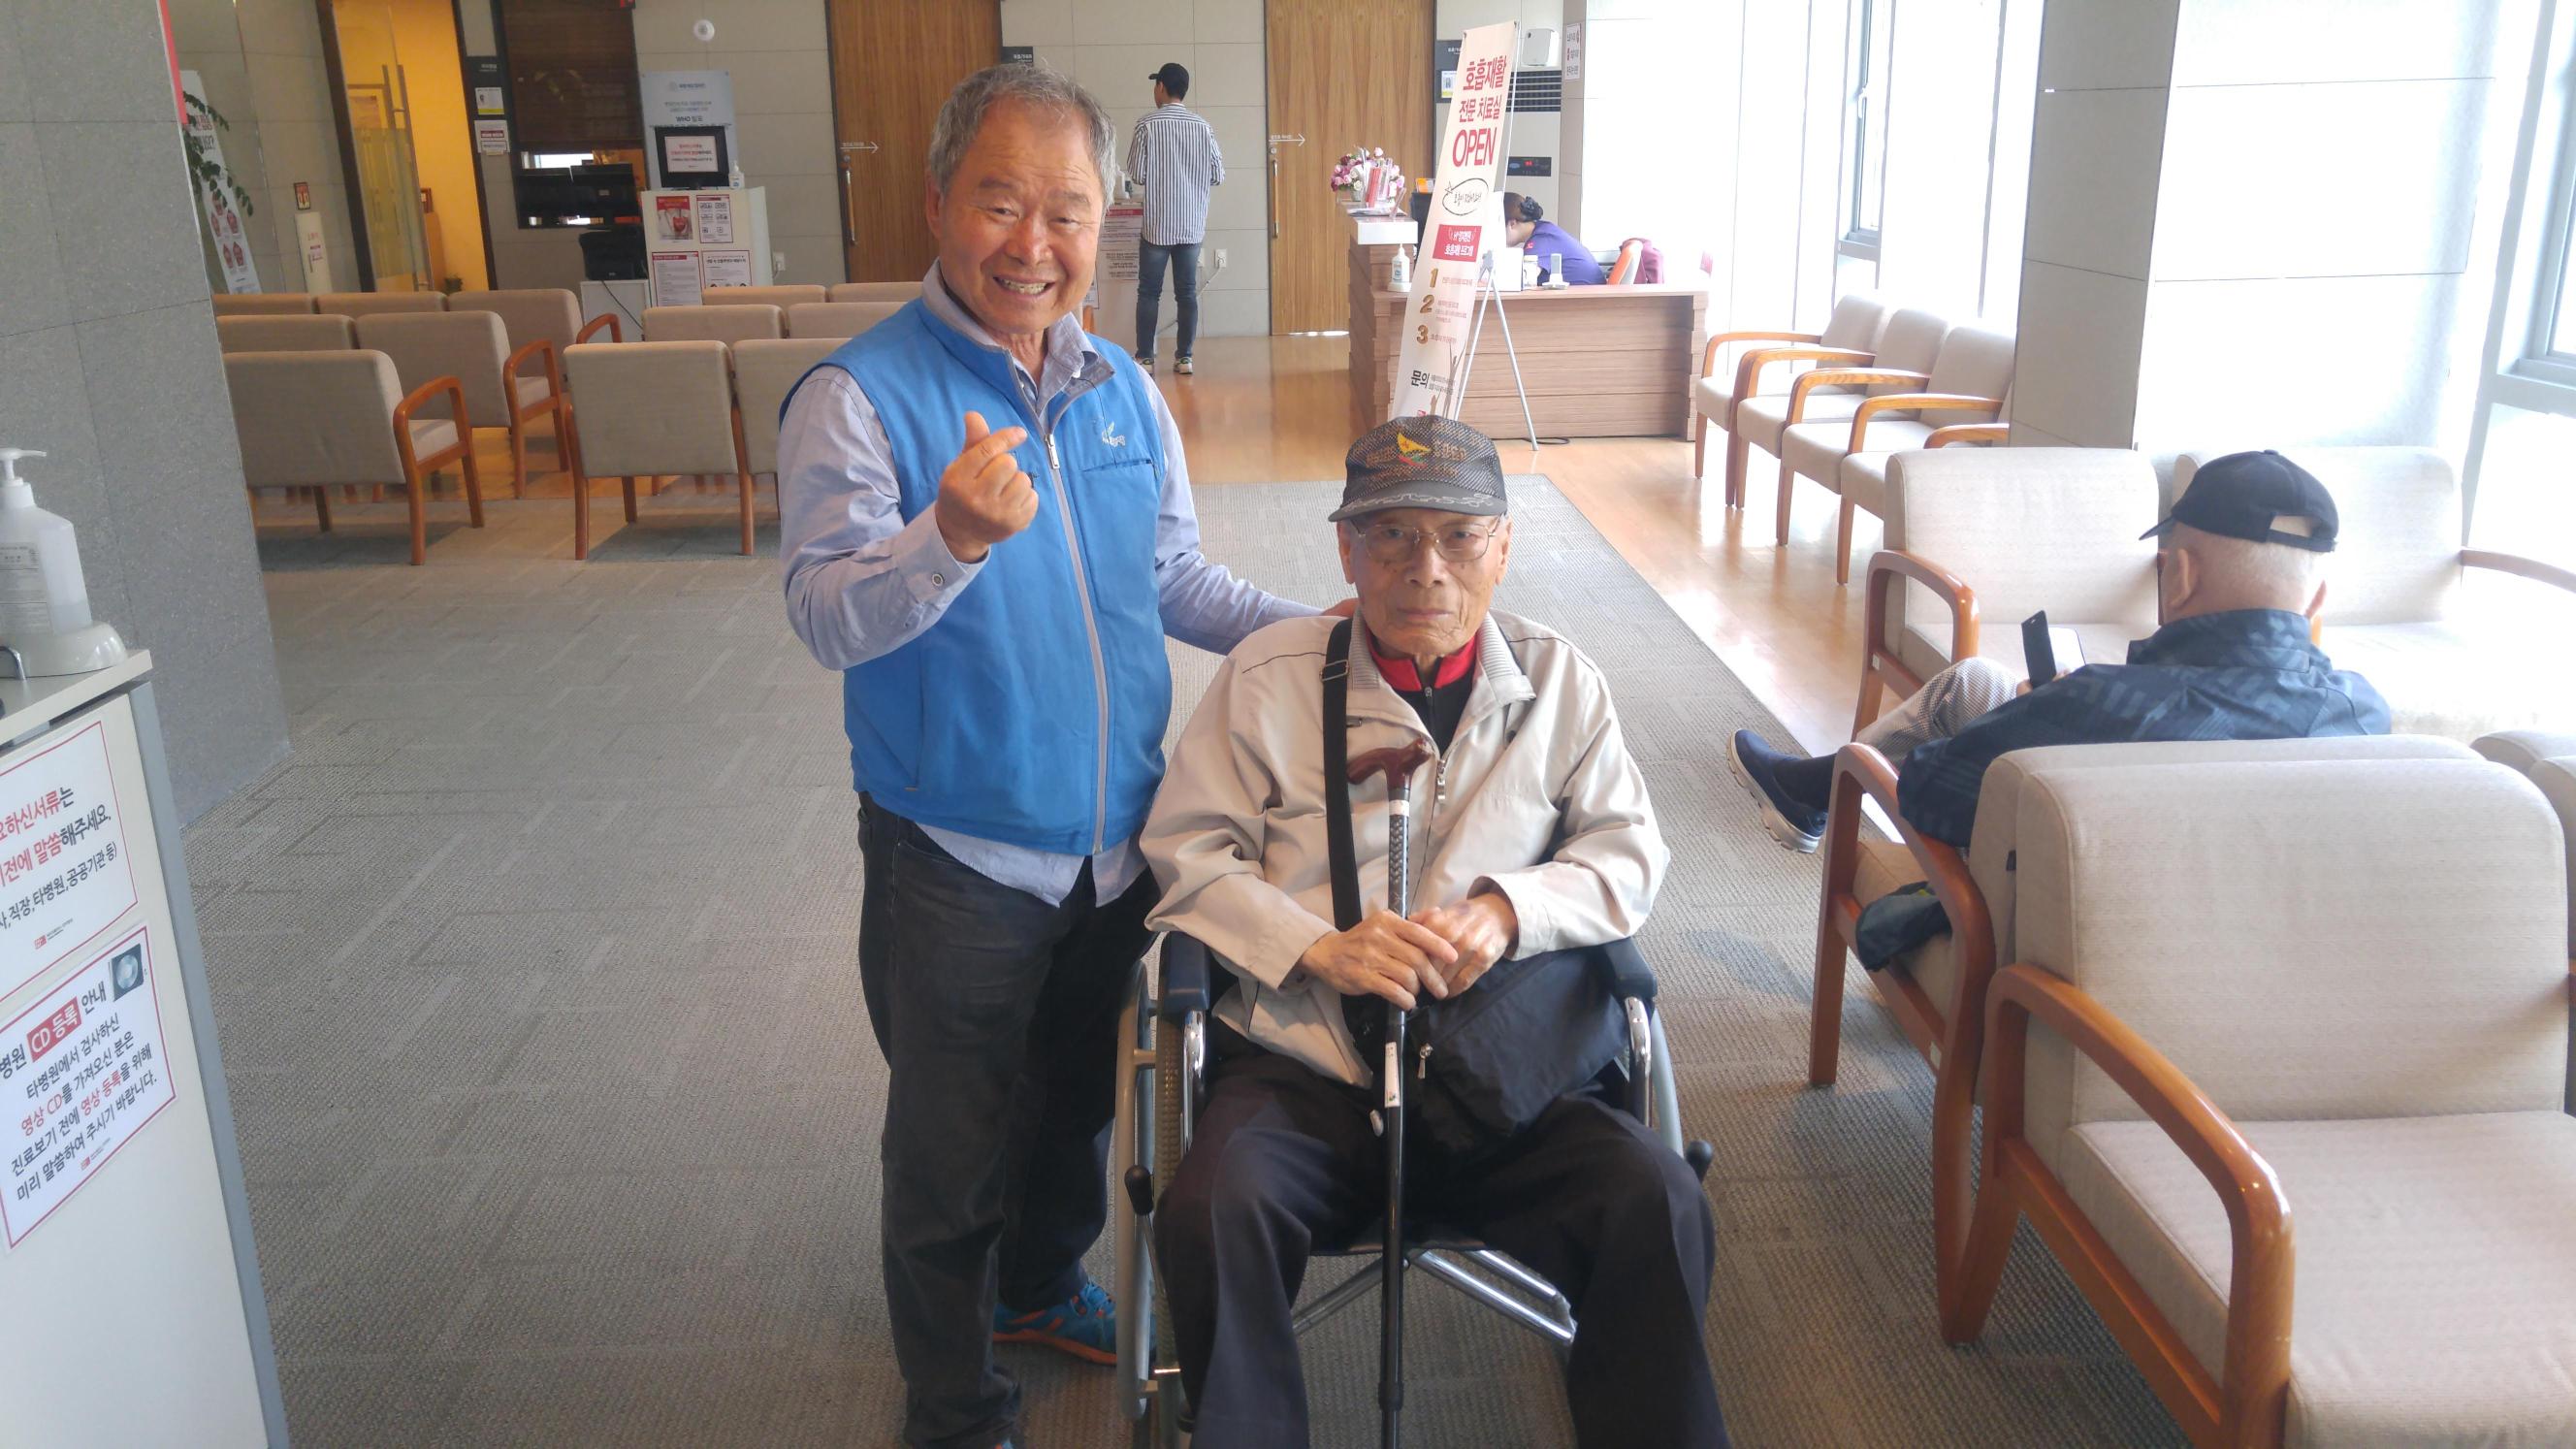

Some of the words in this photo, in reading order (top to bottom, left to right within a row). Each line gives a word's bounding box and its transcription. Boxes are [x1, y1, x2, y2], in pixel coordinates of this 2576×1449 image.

[1463, 55, 1506, 90] 호흡재활
[1459, 99, 1476, 123] 전문
[1477, 95, 1502, 121] 치료실
[1452, 127, 1497, 167] OPEN
[1430, 268, 1438, 288] 1
[1420, 294, 1434, 313] 2
[1416, 325, 1429, 344] 3
[1411, 370, 1430, 389] 문의
[32, 1028, 50, 1052] CD
[52, 1005, 78, 1038] 등록
[81, 981, 107, 1014] 안내
[26, 1046, 80, 1099] 타병원에서
[80, 1013, 120, 1056] 검사하신
[21, 1107, 44, 1136] 영상
[47, 1082, 73, 1114] CD를
[74, 1047, 113, 1090] 가져오신
[114, 1031, 134, 1057] 분은
[12, 1127, 56, 1176] 진료보기
[58, 1107, 80, 1137] 전에
[80, 1087, 100, 1115] 영상
[102, 1062, 130, 1097] 등록을
[132, 1043, 152, 1070] 위해
[16, 1172, 41, 1200] 미리
[43, 1132, 85, 1181] 말씀하여
[86, 1104, 114, 1140] 주시기
[115, 1070, 157, 1111] 바랍니다.
